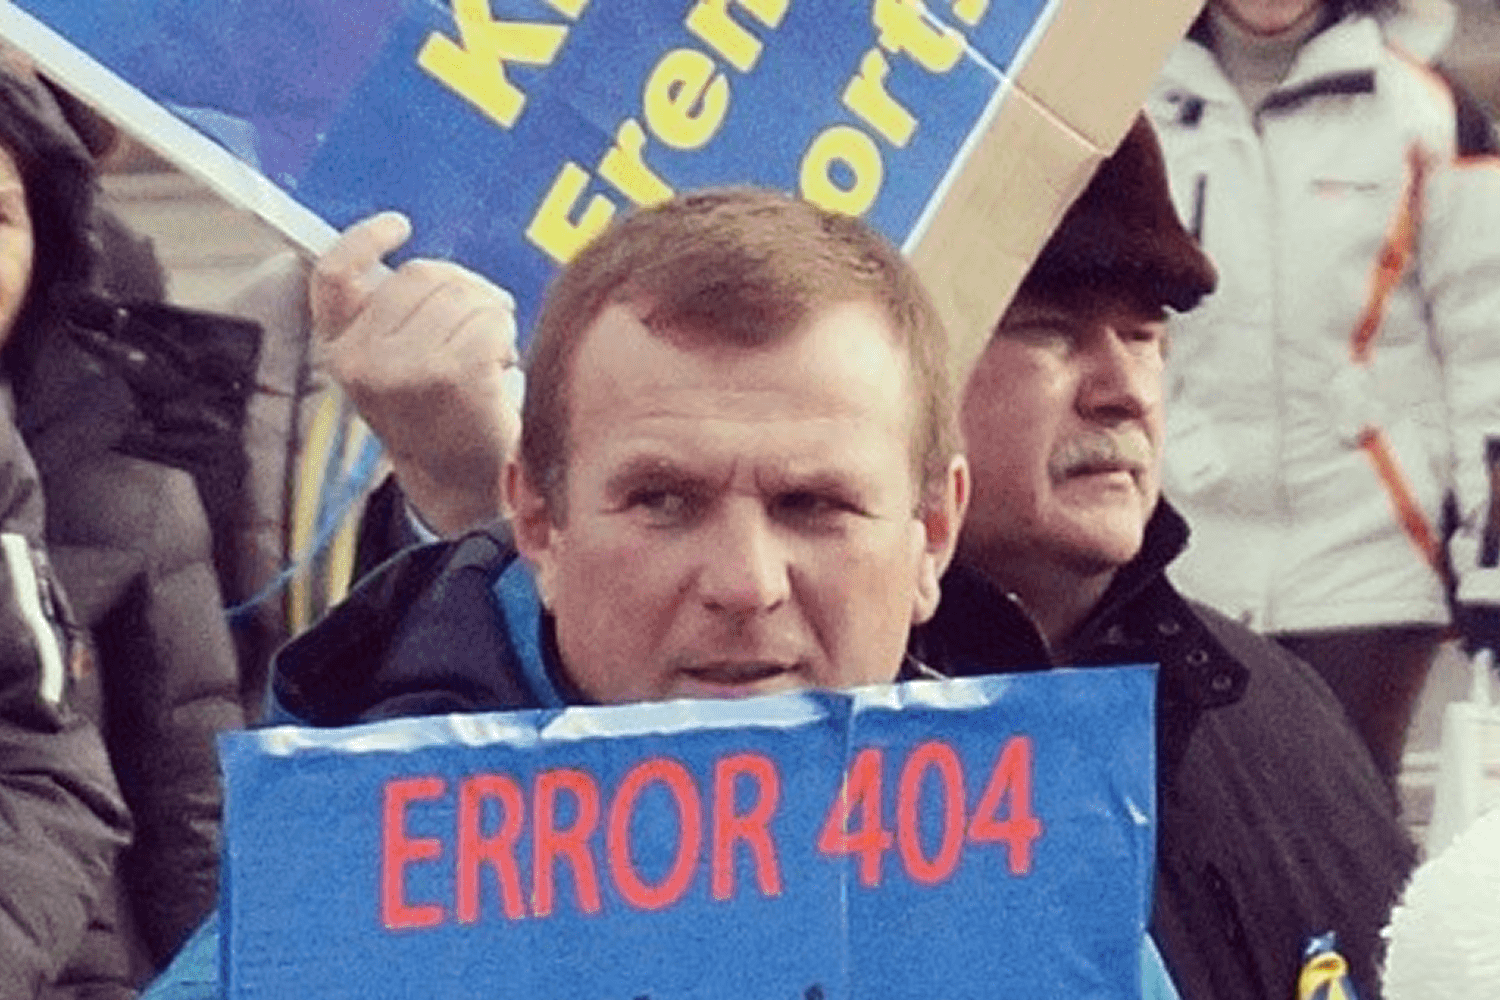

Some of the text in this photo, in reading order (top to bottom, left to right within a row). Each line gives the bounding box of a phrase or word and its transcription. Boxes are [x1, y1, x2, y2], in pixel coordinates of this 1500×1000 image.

[418, 0, 588, 127] K
[800, 0, 988, 217] ort
[381, 736, 1041, 929] ERROR 404
